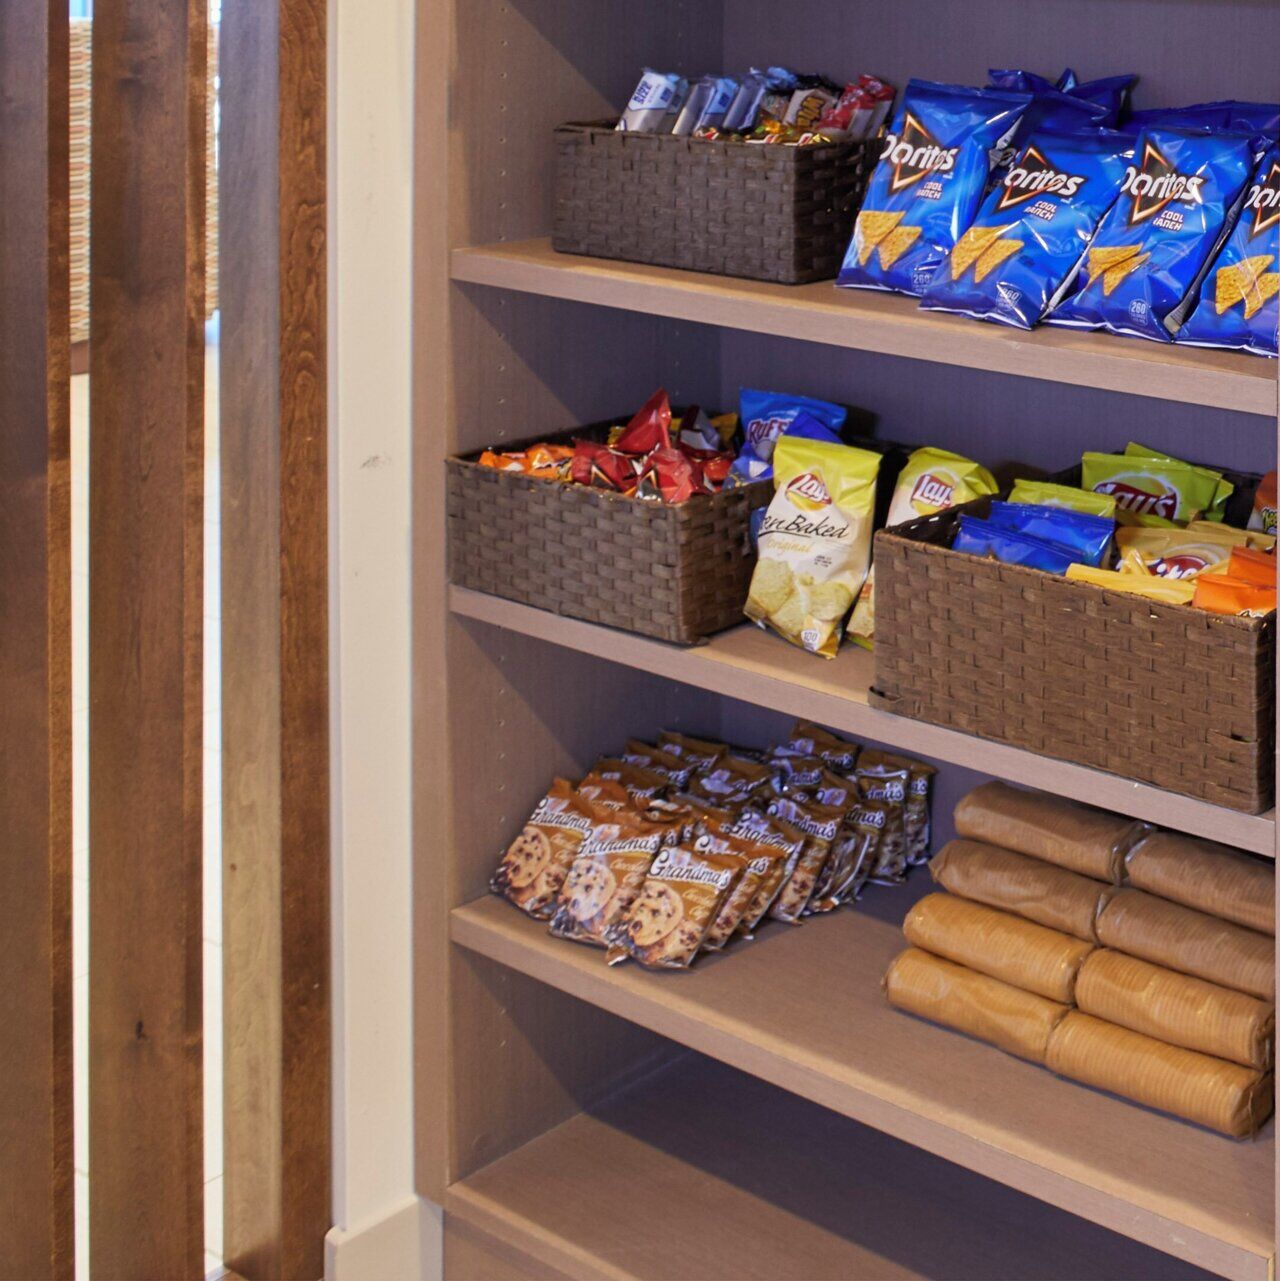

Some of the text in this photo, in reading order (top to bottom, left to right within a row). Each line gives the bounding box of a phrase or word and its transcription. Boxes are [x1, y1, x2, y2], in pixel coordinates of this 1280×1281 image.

[1004, 166, 1085, 197] oritos
[1035, 200, 1057, 213] COOL
[1160, 210, 1184, 222] COOL
[778, 514, 851, 540] Baked
[765, 539, 812, 554] Original
[529, 798, 591, 829] Grandma
[577, 829, 660, 857] Grandma's
[649, 850, 731, 888] Grandma's
